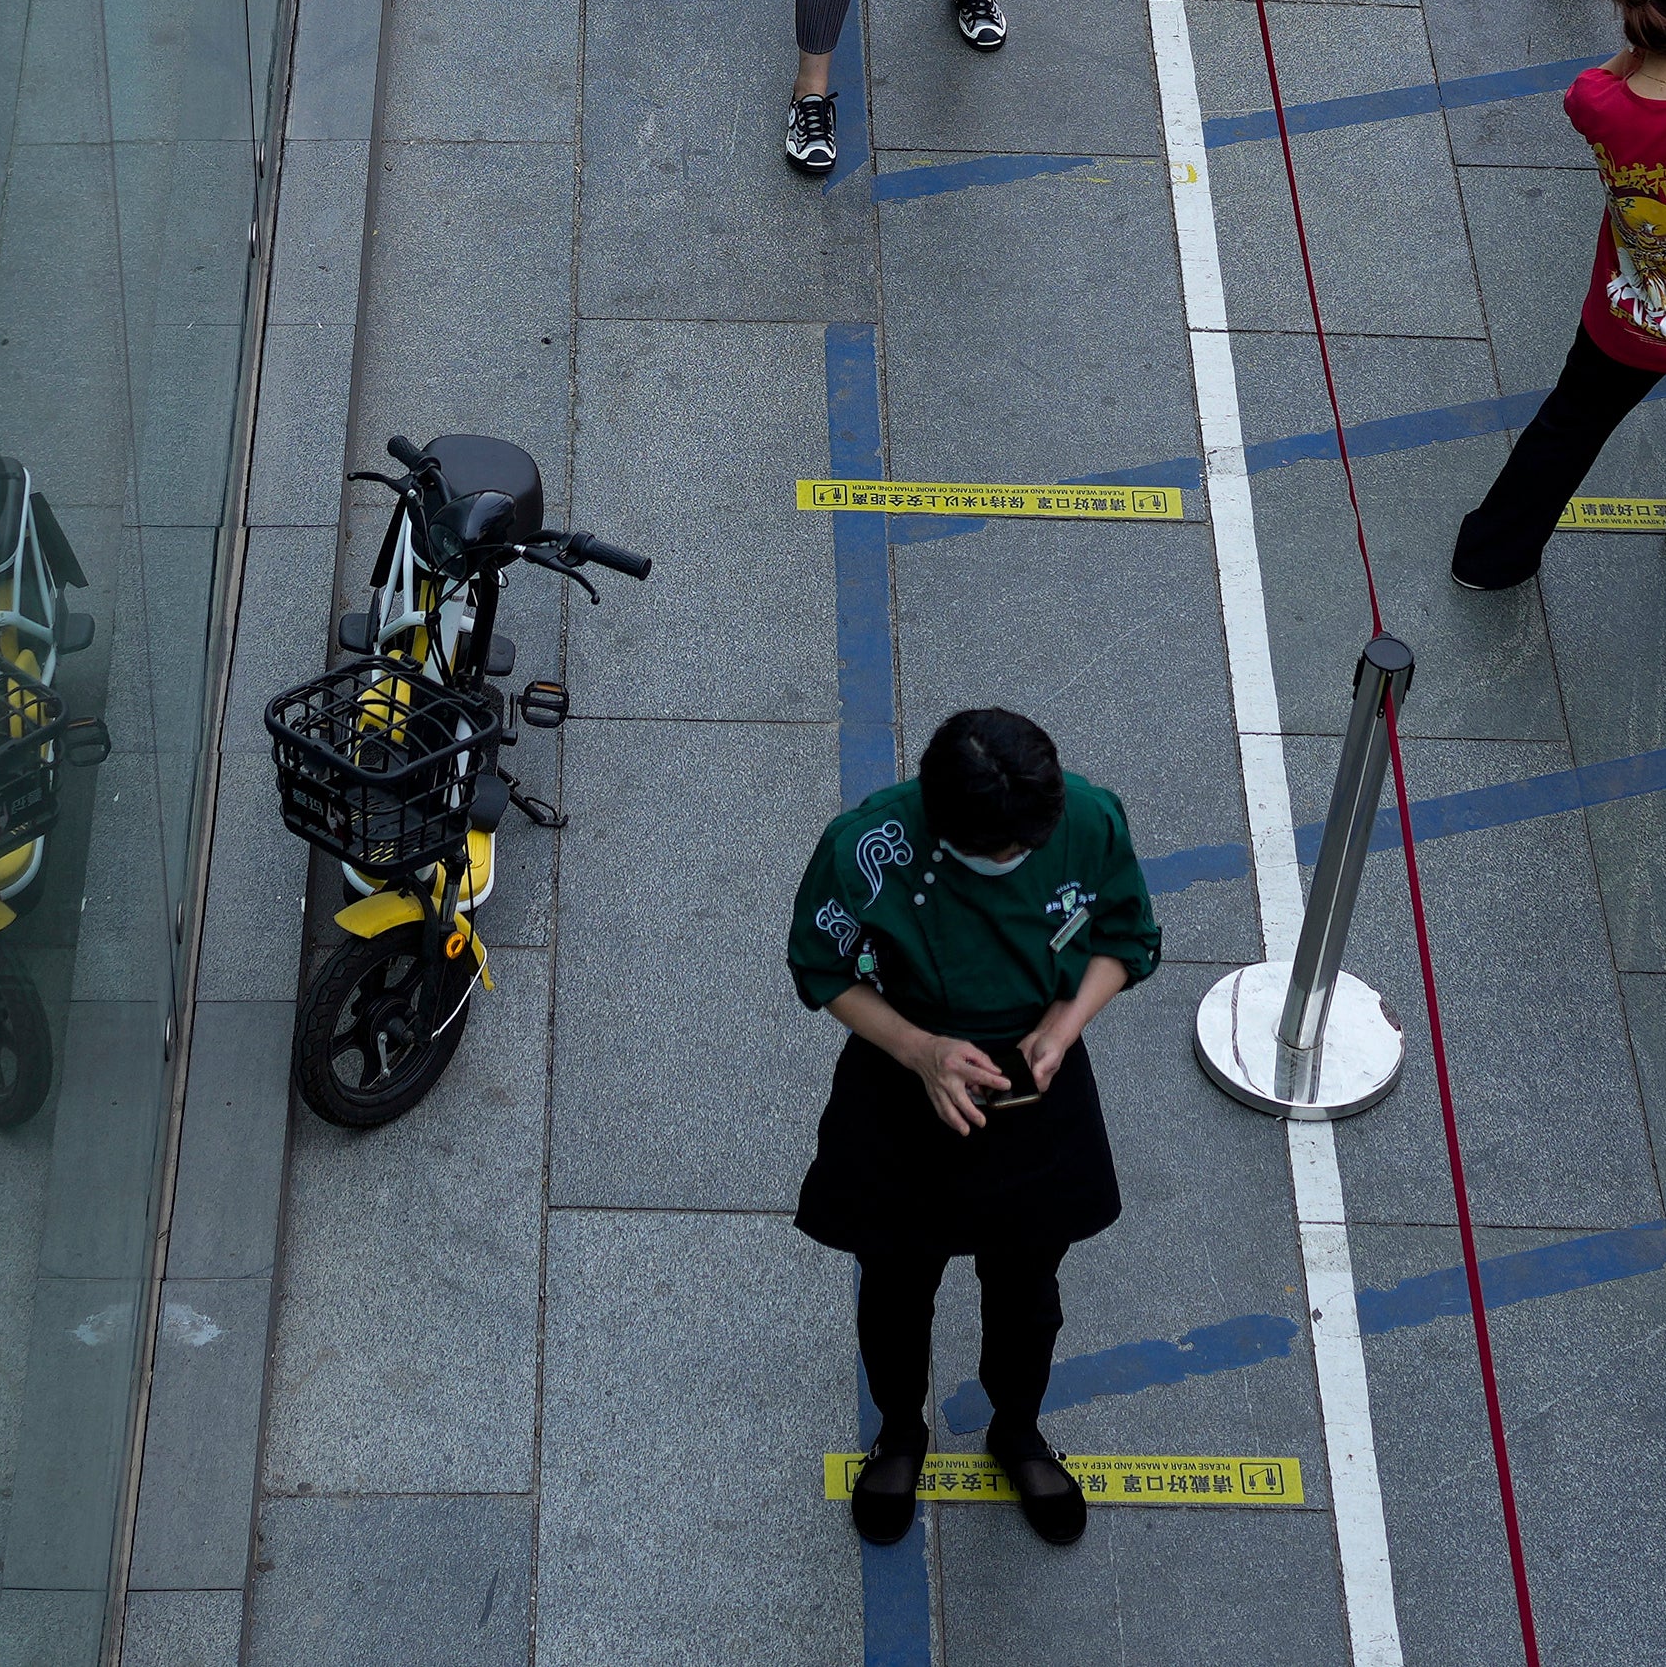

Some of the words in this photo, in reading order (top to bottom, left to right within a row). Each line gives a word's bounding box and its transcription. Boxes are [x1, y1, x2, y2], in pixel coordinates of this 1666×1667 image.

[852, 491, 1024, 509] 保持1米以上安全距离
[1036, 496, 1126, 511] 请戴好口罩
[1580, 501, 1666, 518] 请戴好口罩
[292, 787, 324, 817] 爱玛
[925, 1460, 943, 1468] ONE
[945, 1460, 968, 1468] THAN
[973, 1460, 996, 1468] MORE
[1091, 1461, 1111, 1469] KEEP
[1163, 1462, 1168, 1470] A
[1170, 1462, 1195, 1470] WEAR
[1122, 1474, 1233, 1494] 请戴好口罩
